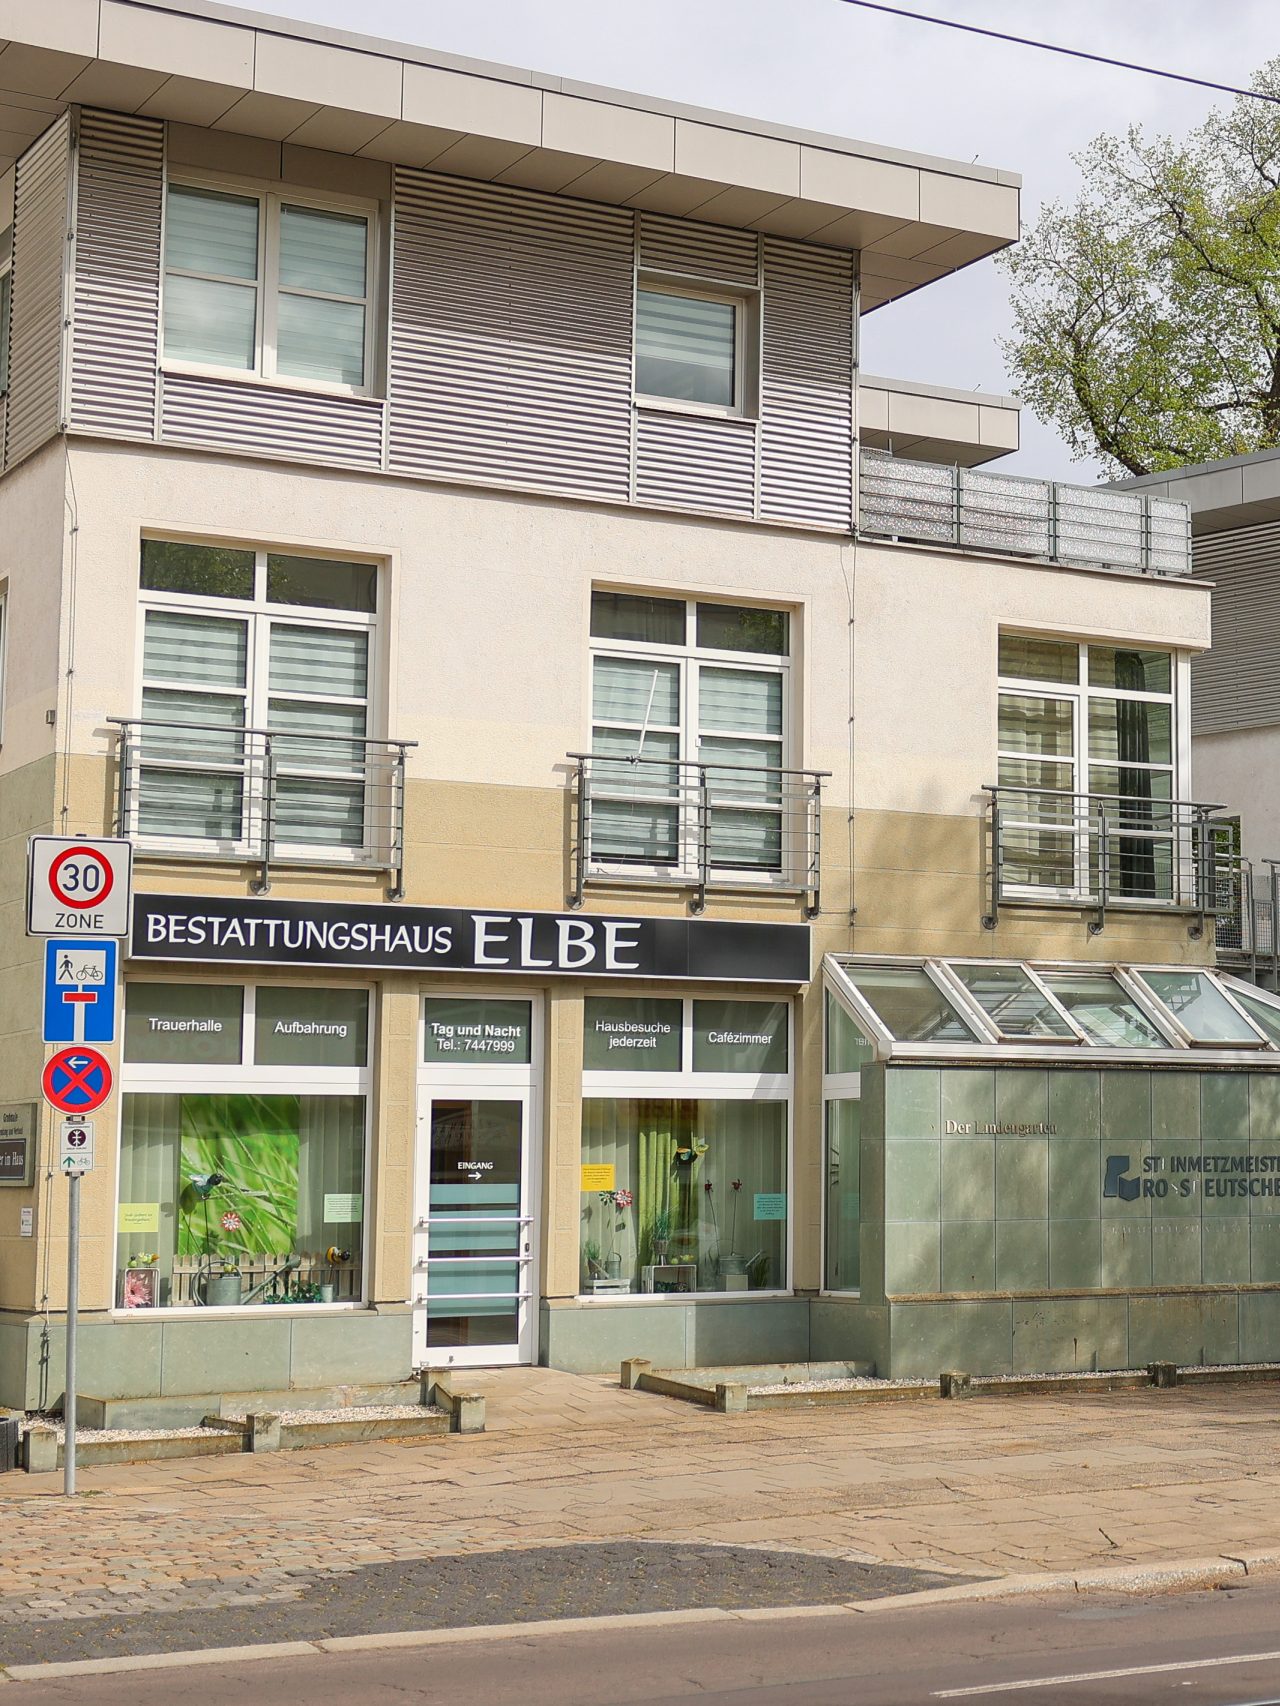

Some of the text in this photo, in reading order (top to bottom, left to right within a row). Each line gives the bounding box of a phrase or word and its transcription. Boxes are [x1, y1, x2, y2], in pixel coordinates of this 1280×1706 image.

[62, 863, 101, 893] 30
[54, 913, 105, 929] ZONE
[146, 913, 642, 970] BESTATTUNGSHAUS ELBE
[148, 1017, 223, 1032] Trauerhalle
[274, 1021, 347, 1037] Aufbahrung
[431, 1023, 521, 1040] Tag und Nacht
[595, 1019, 671, 1033] Hausbesuche
[437, 1038, 515, 1052] Tel.: 7447999
[609, 1034, 657, 1049] jederzeit
[708, 1031, 773, 1045] Cafézimmer
[945, 1119, 1057, 1137] Der Lindengarten
[457, 1161, 494, 1170] EINGANG
